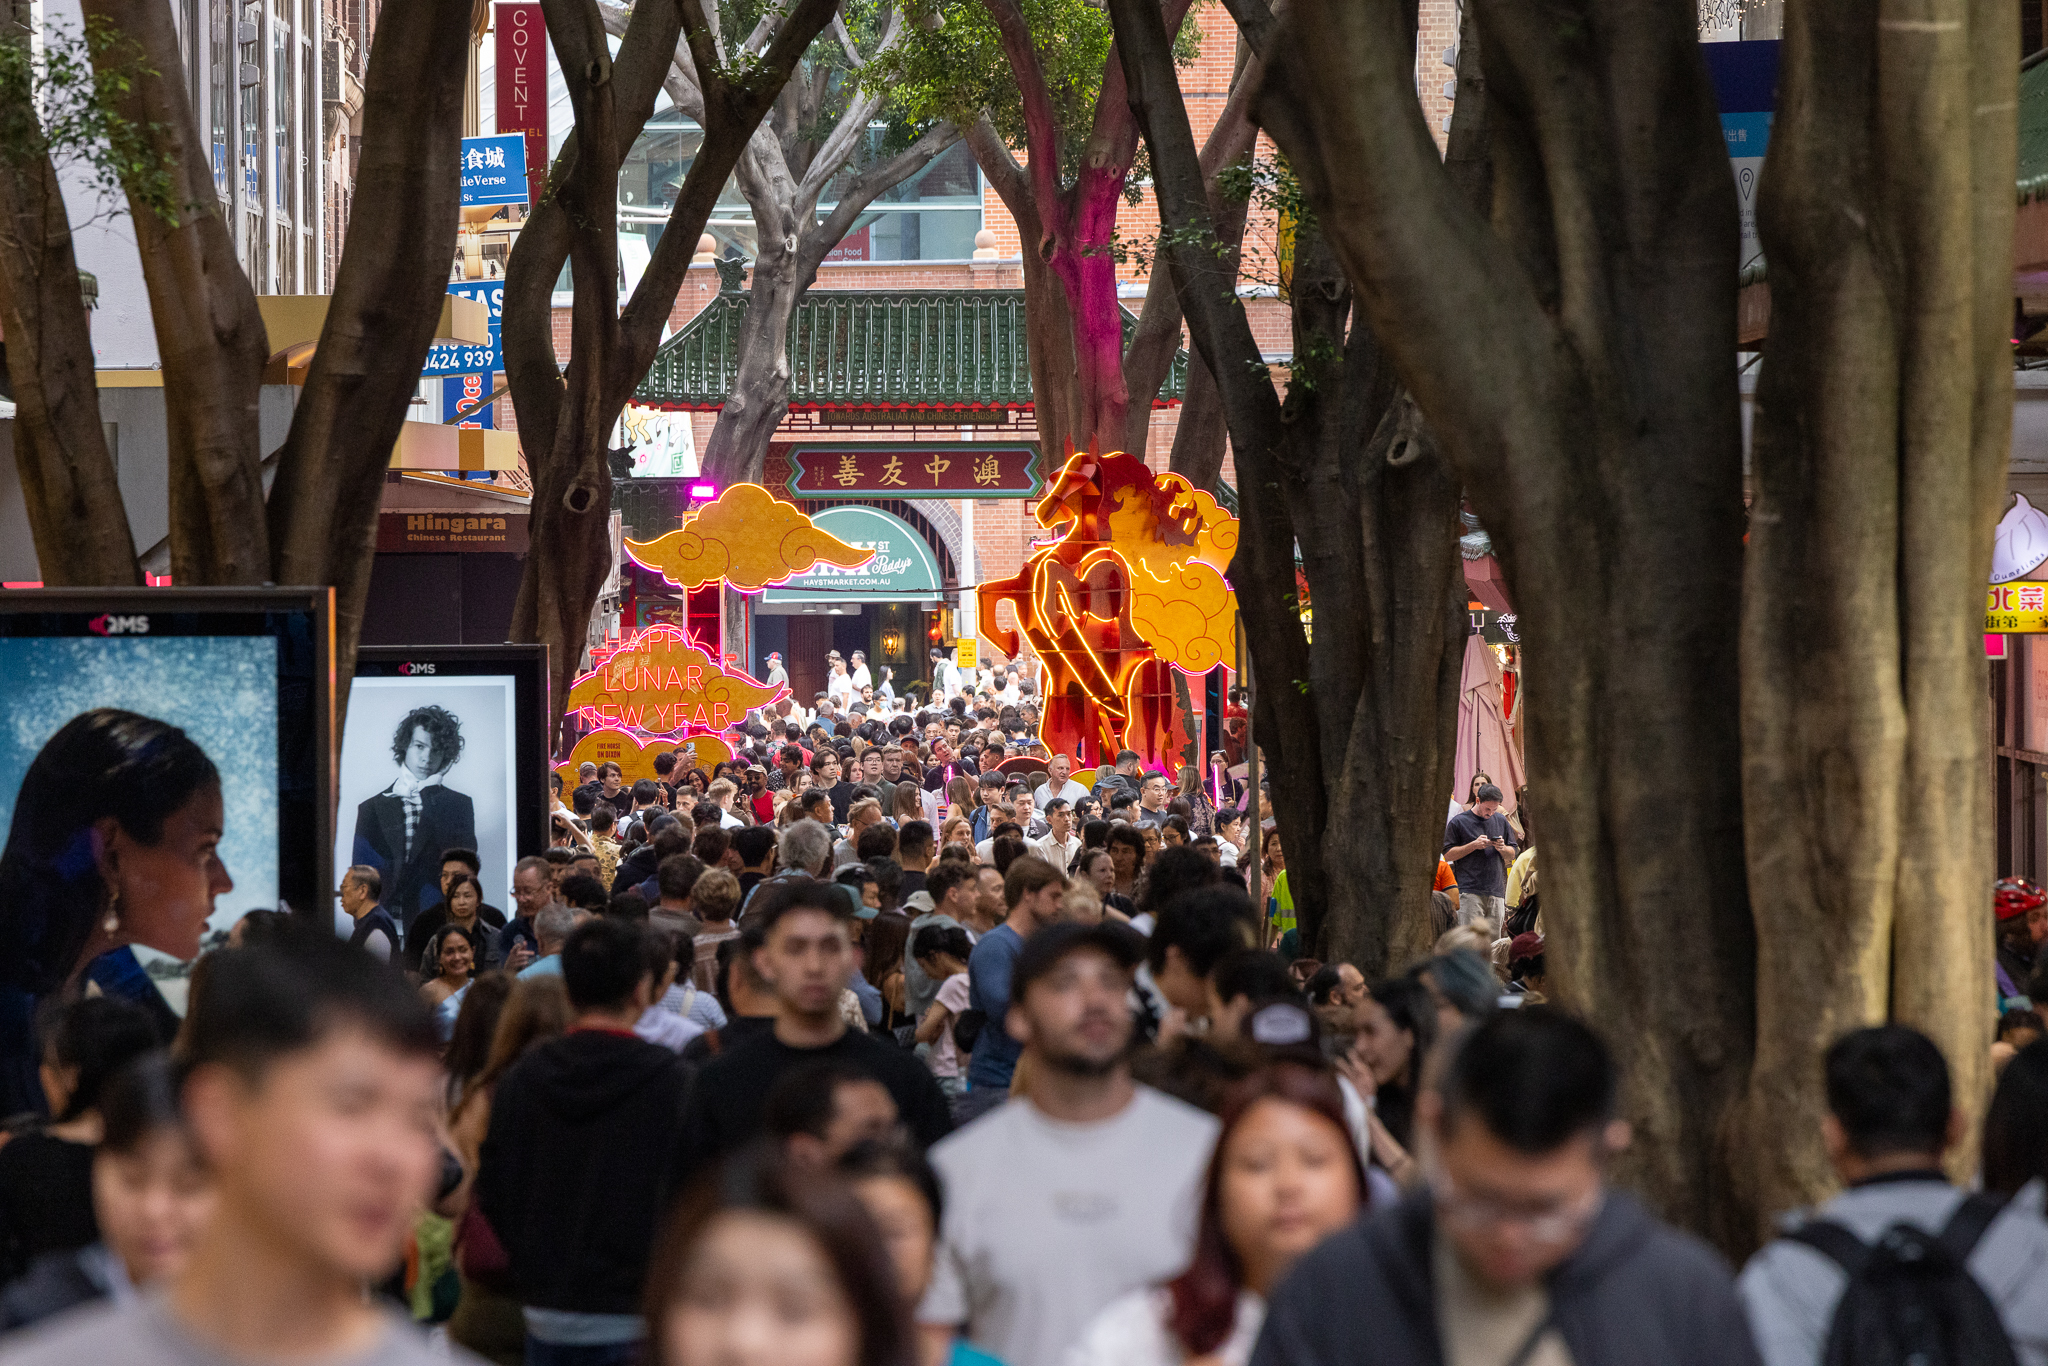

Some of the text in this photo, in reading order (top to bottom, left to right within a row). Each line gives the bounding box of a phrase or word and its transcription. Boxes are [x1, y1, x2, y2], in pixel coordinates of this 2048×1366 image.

[512, 9, 529, 122] COVENT
[1723, 128, 1747, 142] 出售
[844, 247, 862, 256] Food
[464, 350, 494, 368] 939
[827, 411, 1003, 421] TOWARDS AUSTRALIAN AND CHINESE FRIENDSHIP
[407, 514, 507, 533] Hingara
[407, 534, 506, 542] Chinese Restaurant
[1994, 552, 2045, 581] Dumplings
[803, 578, 891, 586] HAYSTMARKET.COM.AU
[604, 627, 702, 653] HAPPY
[604, 665, 704, 692] LUNAR
[578, 702, 730, 730] NEW YEAR
